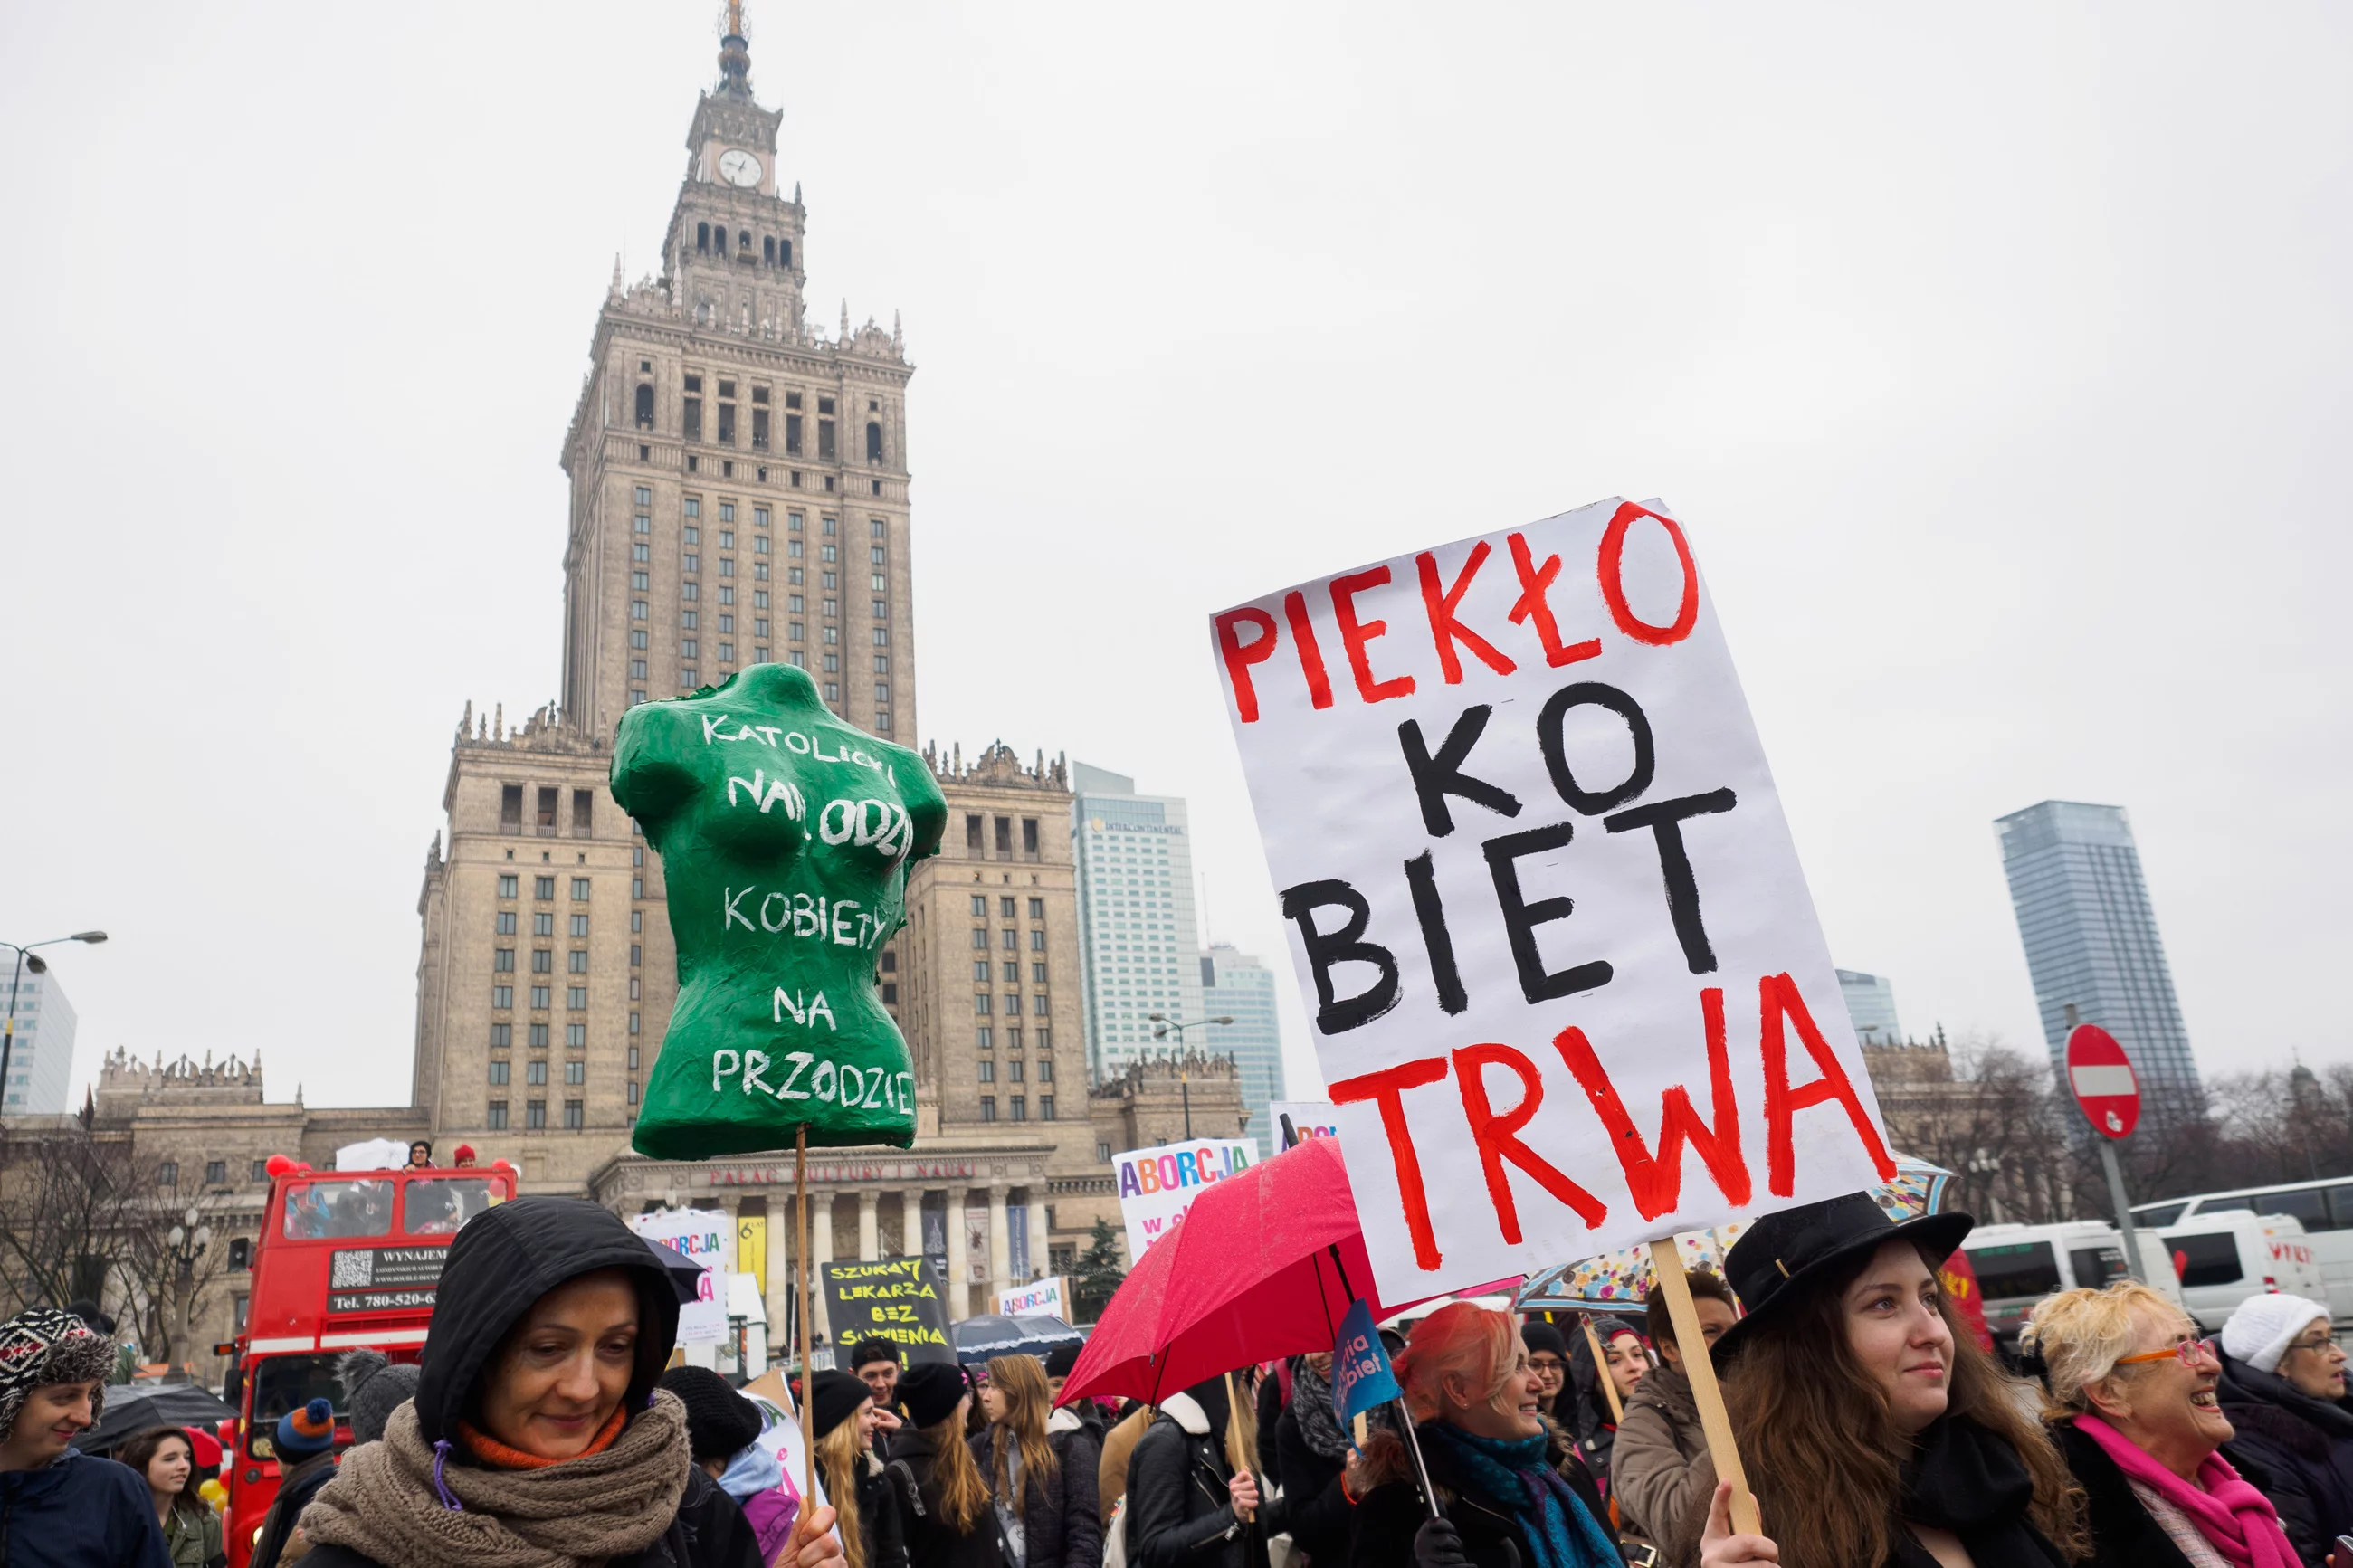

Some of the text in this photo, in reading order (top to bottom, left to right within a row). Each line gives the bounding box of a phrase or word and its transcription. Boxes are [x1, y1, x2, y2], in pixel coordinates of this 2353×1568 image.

[1215, 500, 1700, 724] PIEKŁO
[702, 713, 897, 789] KATOLICKI
[1397, 682, 1655, 839] KO
[724, 885, 887, 950] KOBIETY
[1279, 786, 1738, 1036] BIET
[773, 985, 837, 1031] NA
[713, 1049, 914, 1116] PRZODZIE
[1328, 971, 1899, 1272] TRWA
[917, 1162, 976, 1178] NAUKI
[1121, 1146, 1250, 1199] ABORCJA
[383, 1250, 447, 1263] WYNAJEM
[830, 1259, 922, 1281] SZUKAM
[333, 1297, 360, 1310] Tel.
[839, 1282, 938, 1300] LEKARZA
[871, 1305, 919, 1323] BEZ
[1003, 1288, 1058, 1316] ABORCJA
